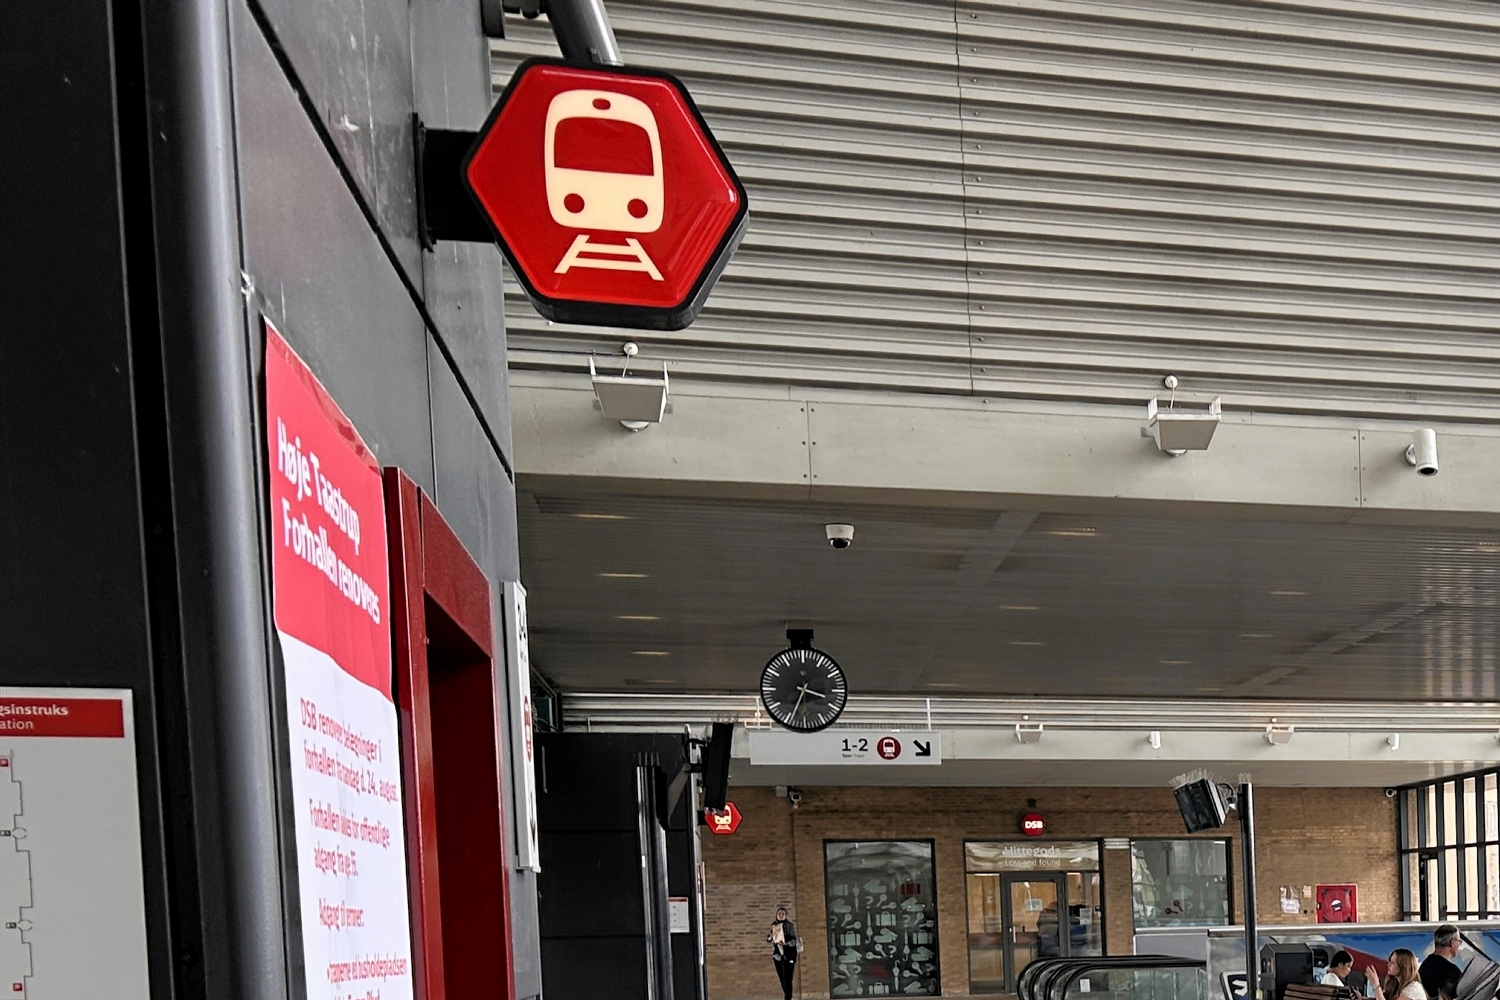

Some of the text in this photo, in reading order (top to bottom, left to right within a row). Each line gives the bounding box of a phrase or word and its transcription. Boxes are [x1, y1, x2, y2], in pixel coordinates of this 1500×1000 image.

[277, 415, 361, 556] Høje Taastrup
[281, 496, 381, 625] Forhallen renoveres
[300, 697, 317, 731] DSB
[842, 738, 868, 752] 1-2
[1025, 821, 1043, 829] DSB
[1004, 845, 1060, 857] Hittegods
[1039, 858, 1061, 867] found
